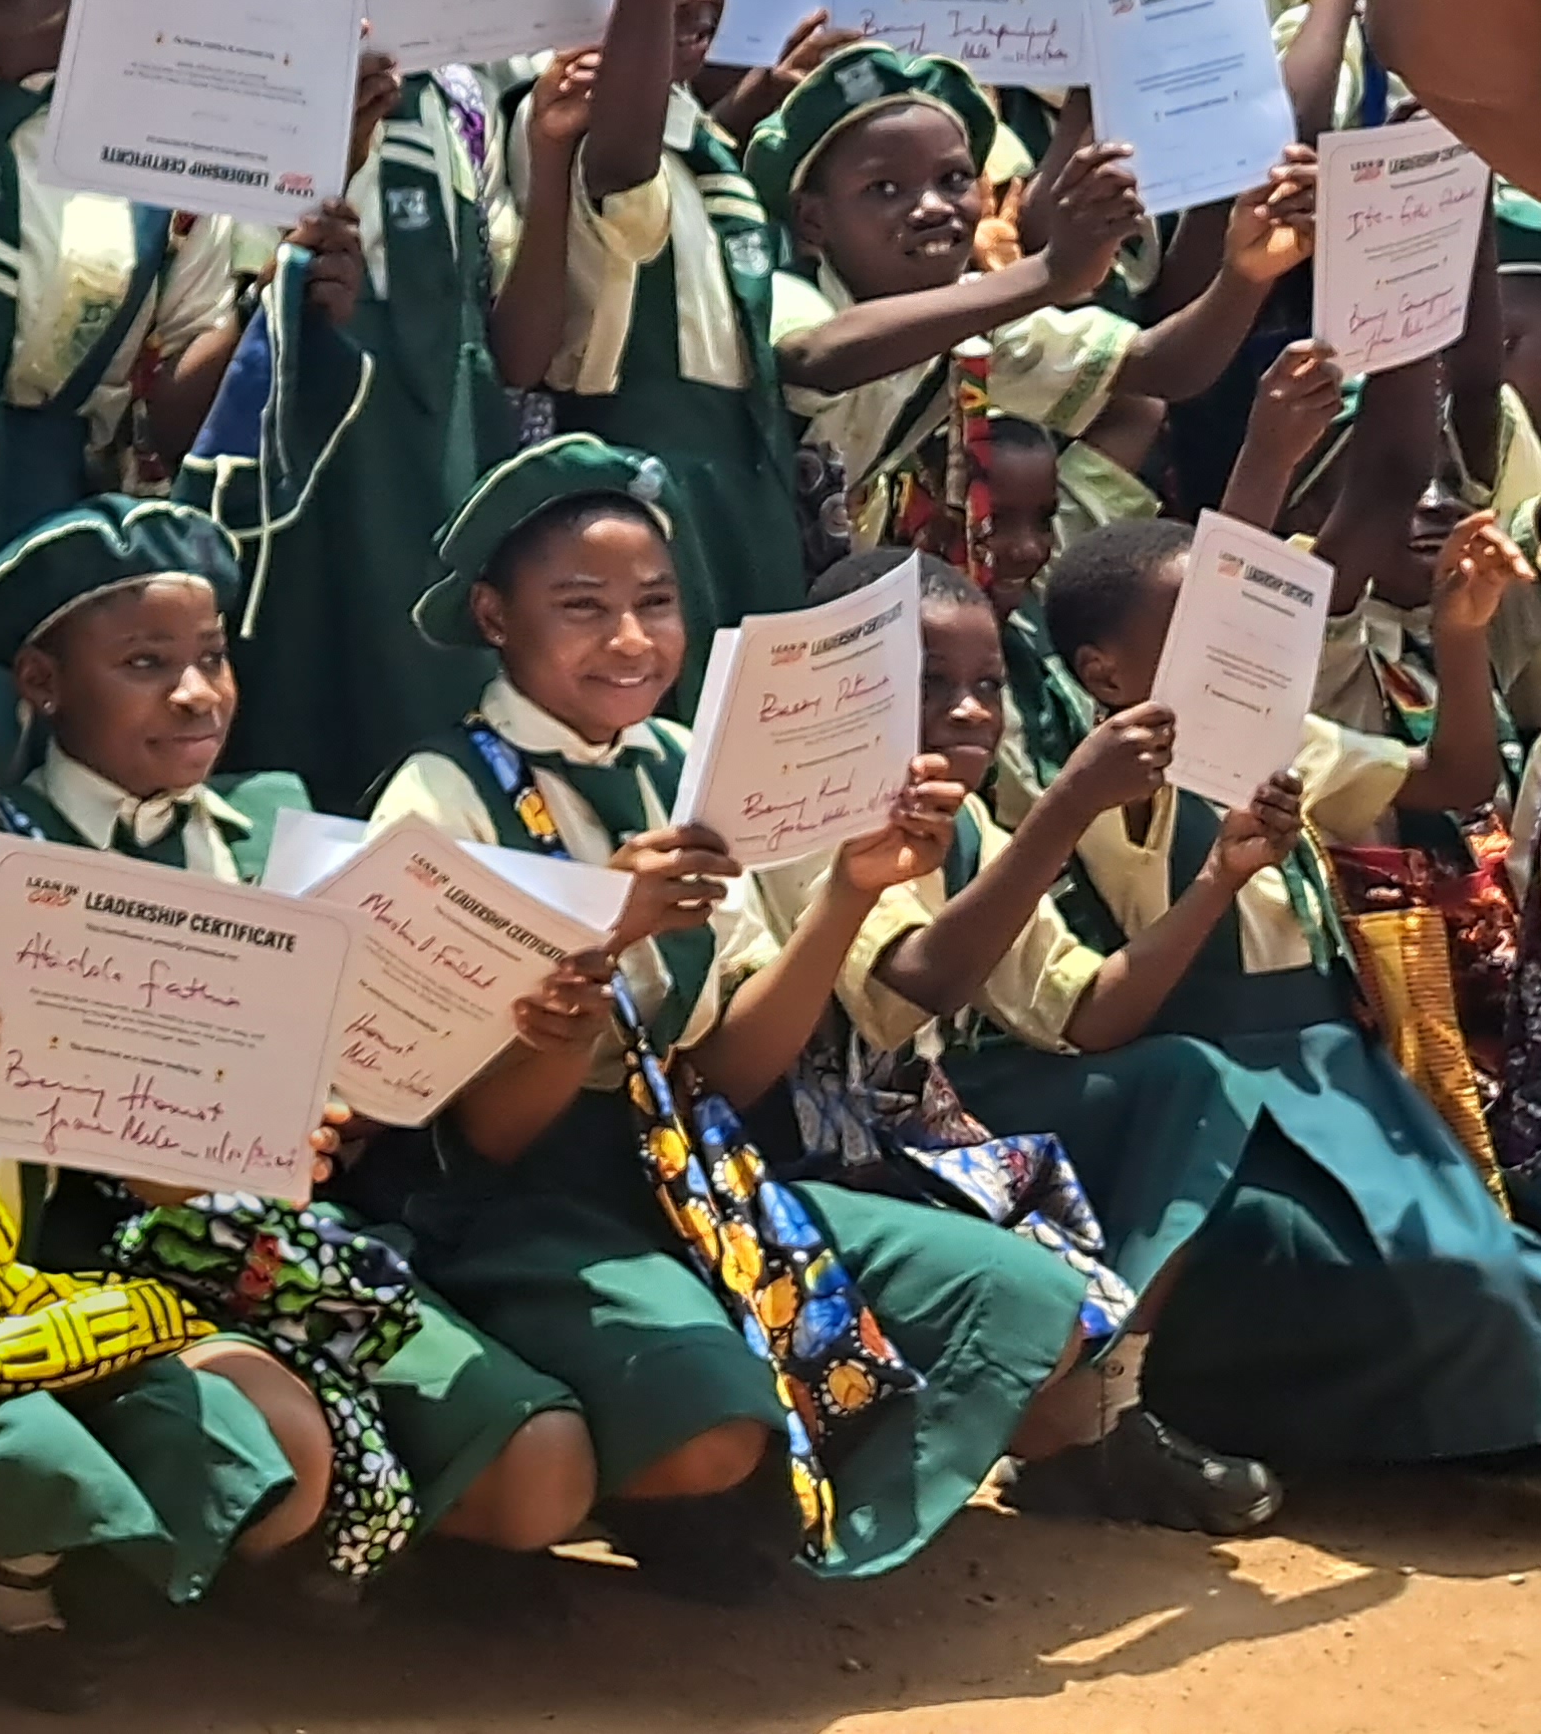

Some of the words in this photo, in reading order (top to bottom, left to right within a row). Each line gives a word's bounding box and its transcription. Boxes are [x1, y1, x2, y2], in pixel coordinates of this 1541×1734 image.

[101, 146, 186, 177] CERTIFICATE
[187, 161, 269, 188] LEADERSHIP
[85, 891, 189, 933] LEADERSHIP
[191, 912, 298, 953] CERTIFICATE
